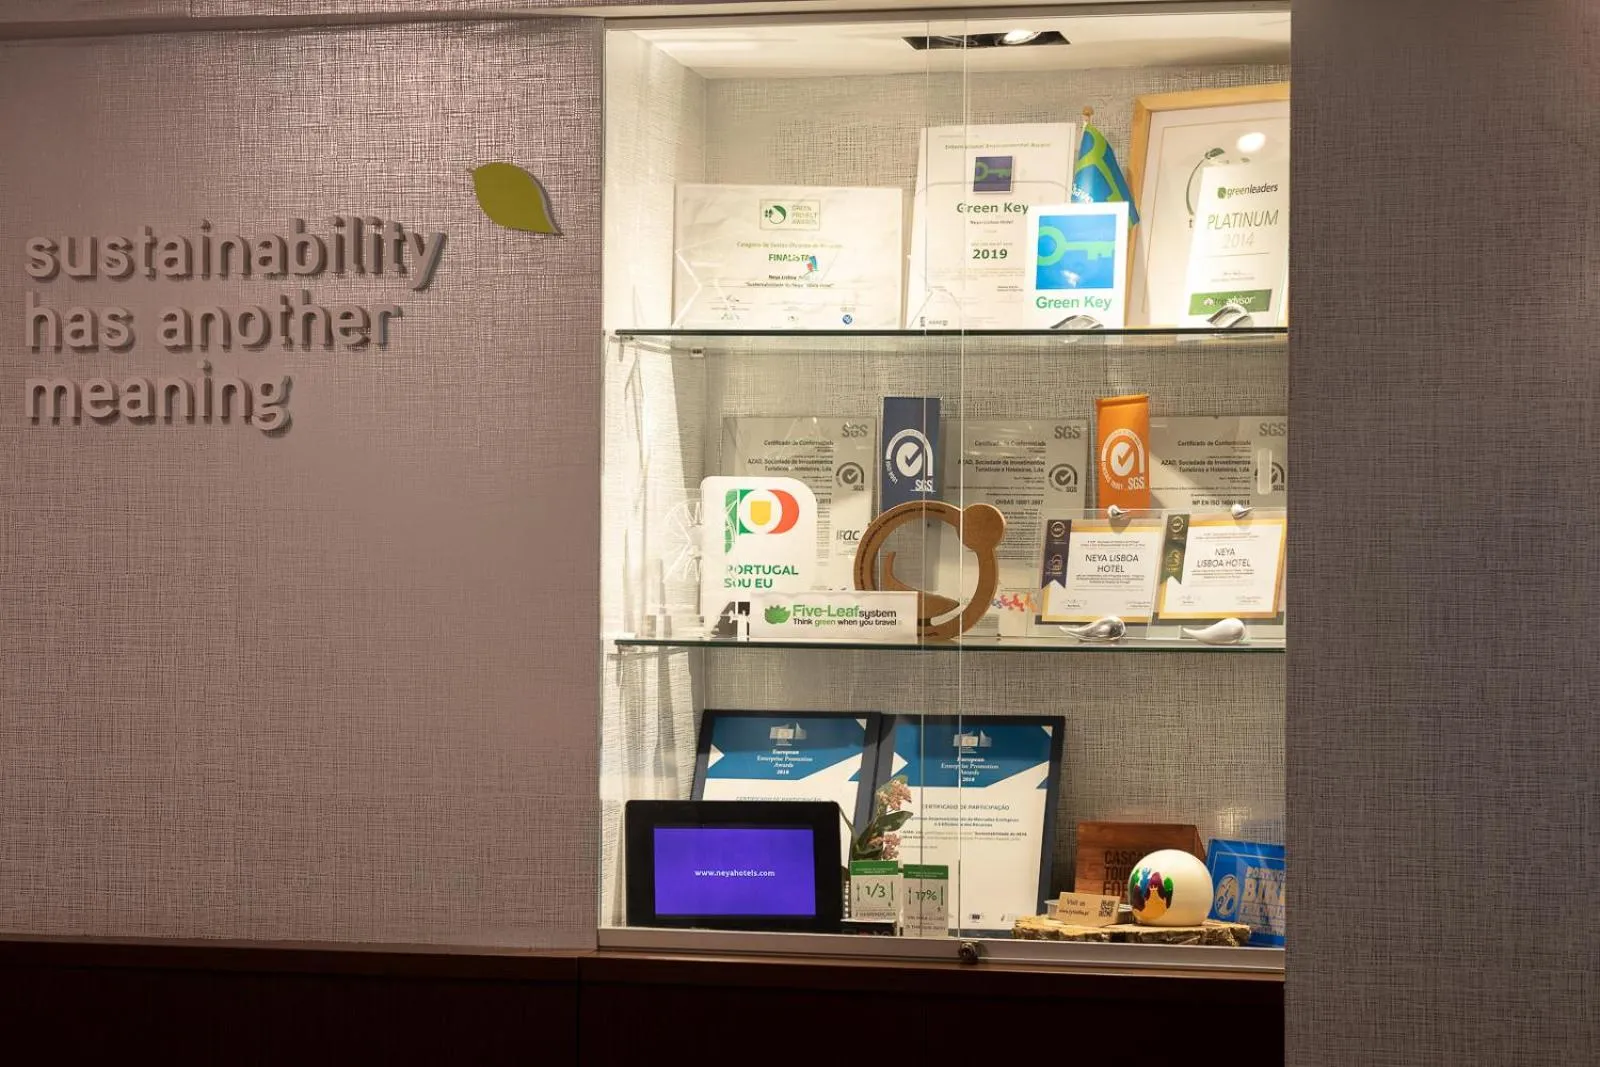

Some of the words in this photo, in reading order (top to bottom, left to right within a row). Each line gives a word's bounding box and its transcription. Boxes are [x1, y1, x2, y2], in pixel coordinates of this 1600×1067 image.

[1226, 183, 1279, 199] greenleaders
[956, 202, 999, 214] Green
[1003, 202, 1029, 215] Key
[1207, 209, 1279, 230] PLATINUM
[1222, 231, 1255, 249] 2014
[24, 216, 445, 291] sustainability
[971, 248, 1008, 260] 2019
[1035, 296, 1081, 310] Green
[1084, 295, 1113, 312] Key
[24, 291, 134, 350] has
[157, 291, 401, 350] another
[24, 361, 292, 435] meaning
[842, 424, 868, 438] SGS
[1054, 425, 1081, 439] SGS
[1259, 422, 1286, 437] SGS
[914, 479, 934, 492] SGS
[1127, 476, 1145, 490] SGS
[1085, 554, 1108, 562] NEYA
[1109, 554, 1139, 562] LISBOA
[1215, 547, 1236, 556] NEYA
[726, 564, 799, 575] PORTUGAL
[1096, 565, 1125, 573] HOTEL
[1196, 559, 1224, 568] LISBOA
[1225, 558, 1251, 568] HOTEL
[724, 578, 751, 589] SOU
[755, 578, 774, 589] EU
[793, 618, 813, 626] Think
[814, 619, 836, 627] green
[837, 618, 858, 626] when
[859, 619, 874, 628] you
[874, 618, 897, 626] travel
[694, 869, 775, 878] www.neyahotels.com
[865, 882, 886, 898] 1/3
[915, 889, 938, 902] 17%
